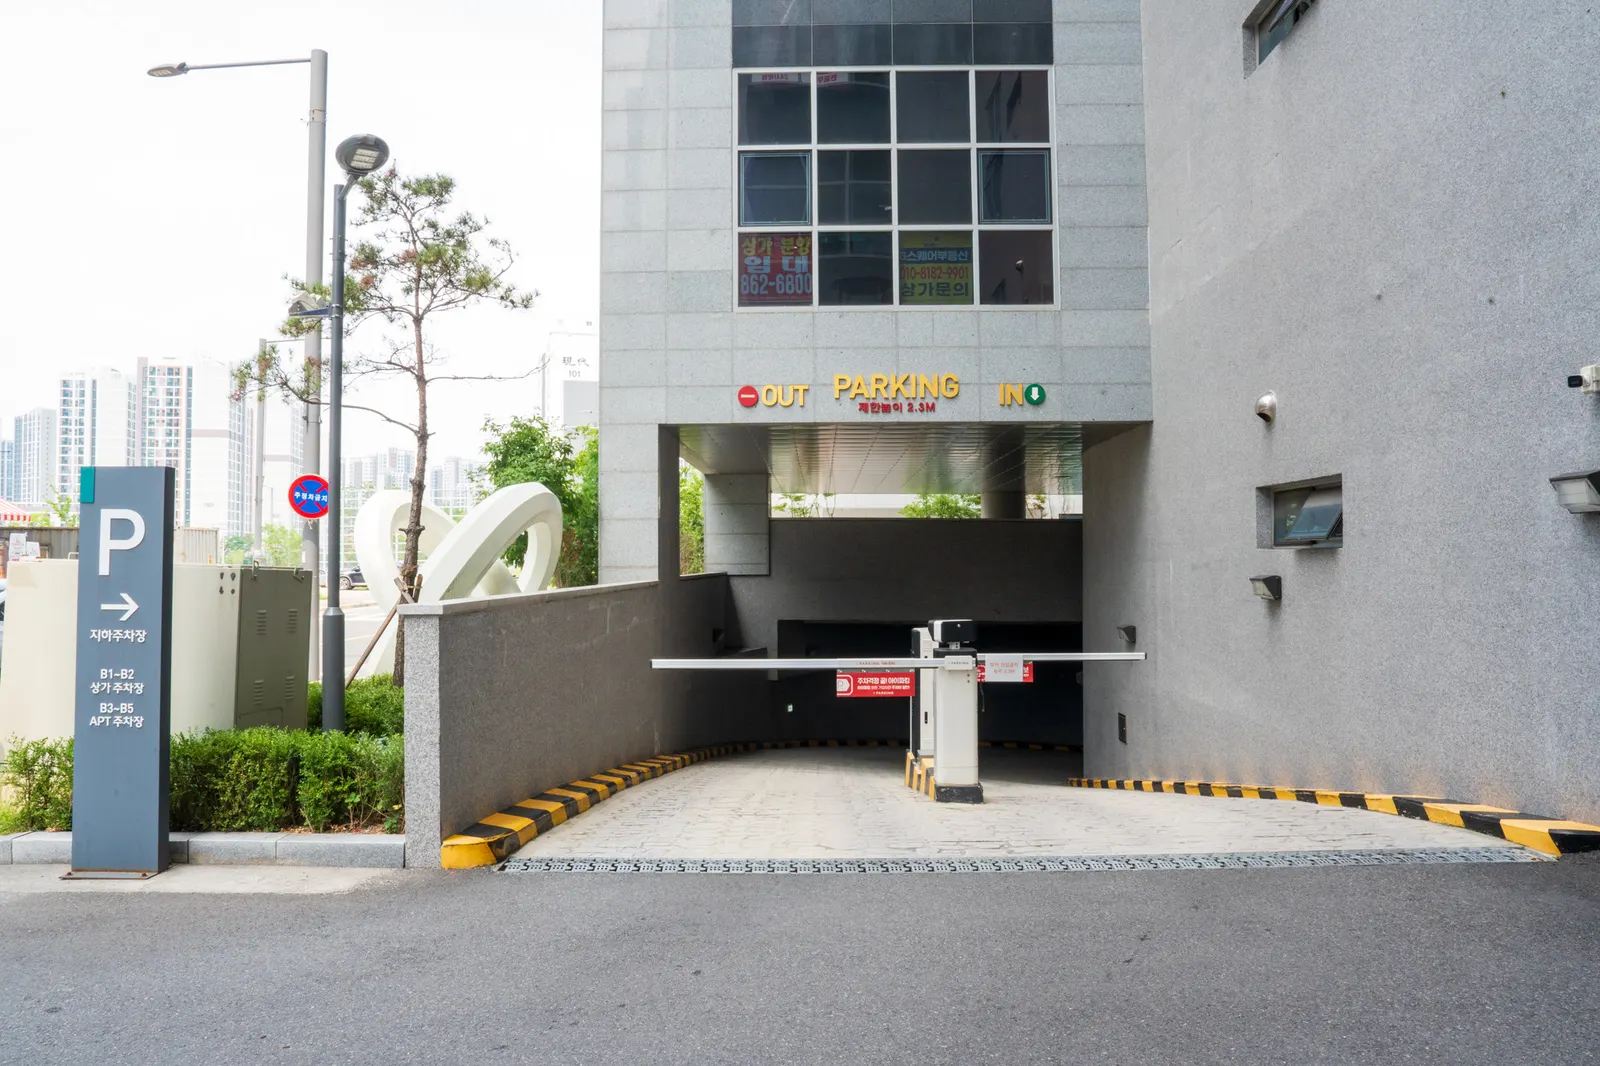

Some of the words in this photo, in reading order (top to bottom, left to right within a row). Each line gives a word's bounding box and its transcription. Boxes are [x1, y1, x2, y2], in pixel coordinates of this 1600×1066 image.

[741, 236, 772, 256] 상가
[740, 273, 812, 295] 862-6800
[568, 370, 581, 378] 101
[833, 373, 960, 400] PARKING
[761, 384, 809, 407] OUT
[999, 383, 1023, 406] IN
[907, 402, 936, 413] 2.3M
[294, 491, 328, 503] 주정차금지
[98, 508, 146, 576] P
[89, 629, 147, 643] 지하주차장
[100, 668, 135, 680] B1~B2
[90, 682, 111, 695] 상가
[113, 682, 144, 695] 주차장
[99, 702, 134, 714] B3~B5
[89, 716, 112, 727] APT
[113, 715, 144, 728] 주차장
